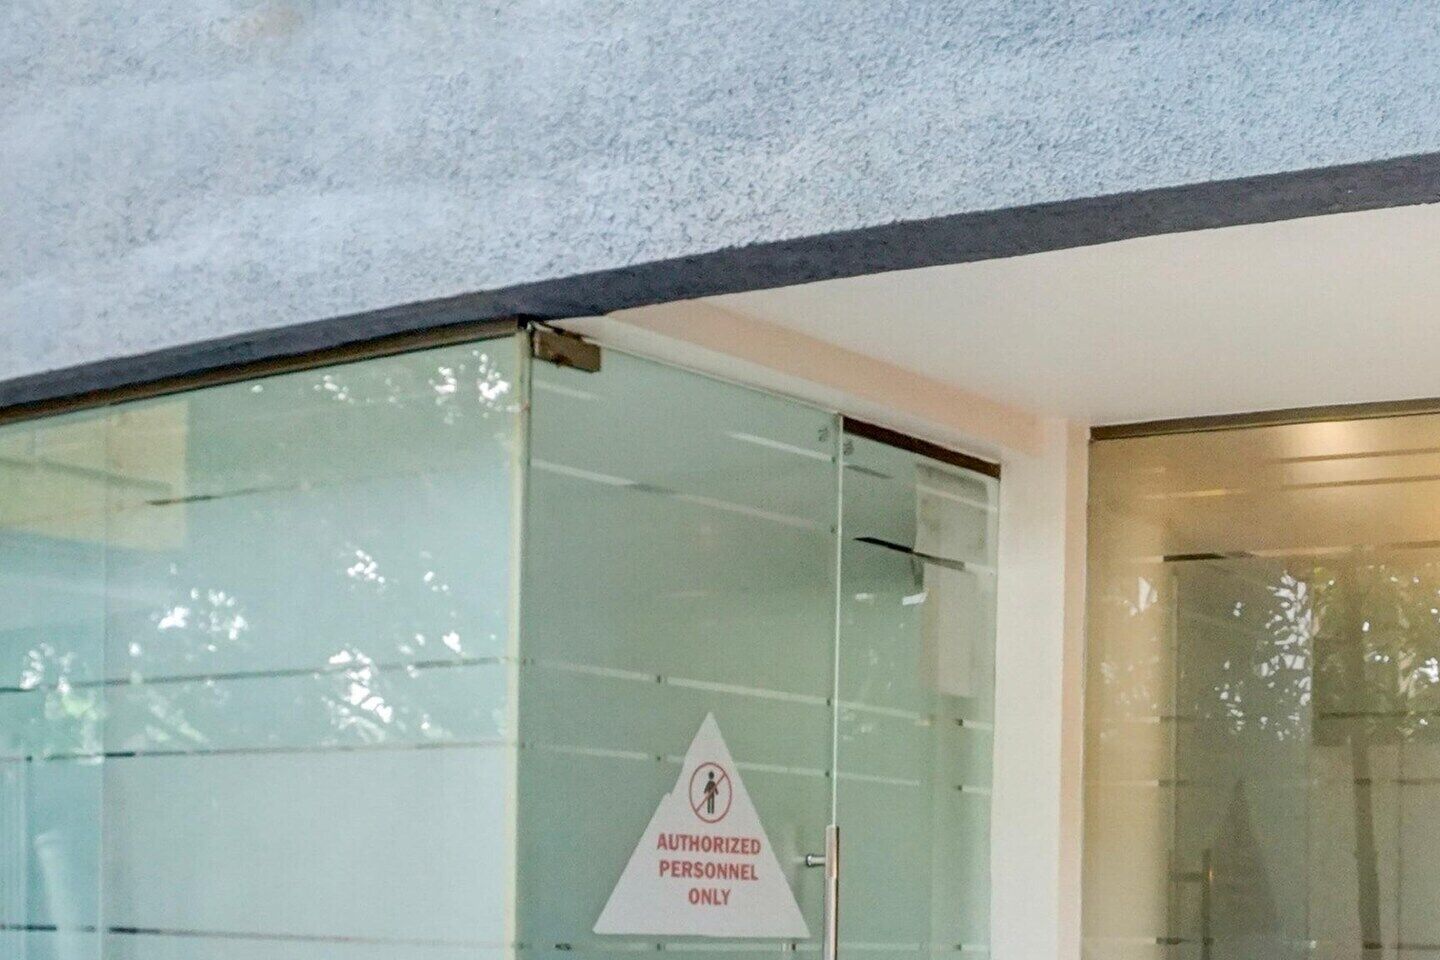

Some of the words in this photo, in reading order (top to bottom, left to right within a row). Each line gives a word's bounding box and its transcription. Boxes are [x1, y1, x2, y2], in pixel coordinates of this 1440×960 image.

[656, 833, 762, 855] AUTHORIZED
[659, 860, 759, 881] PERSONNEL
[688, 888, 732, 906] ONLY
